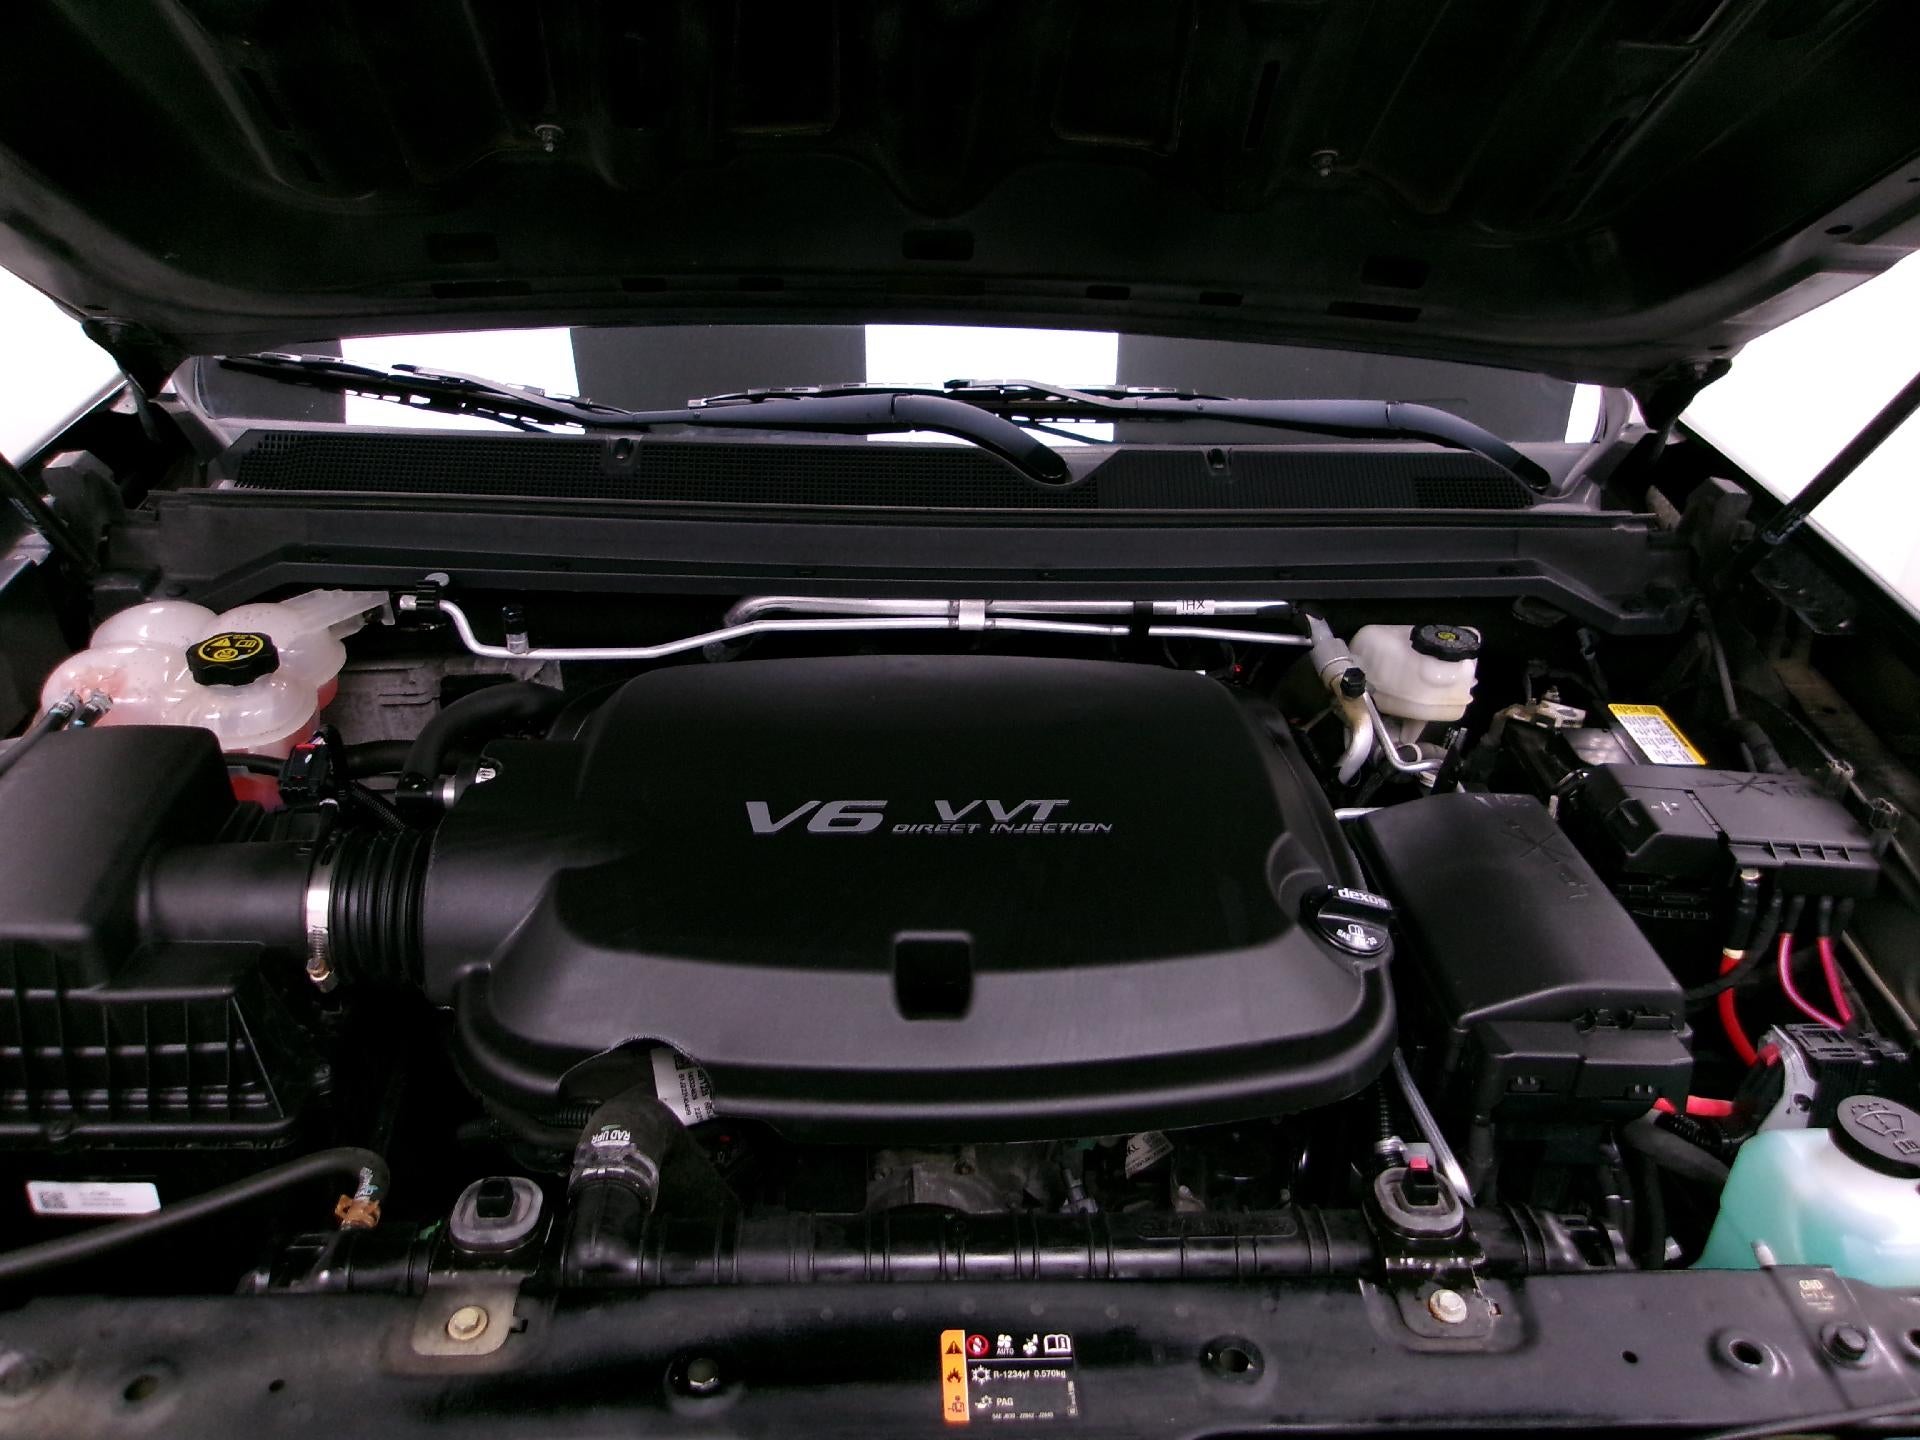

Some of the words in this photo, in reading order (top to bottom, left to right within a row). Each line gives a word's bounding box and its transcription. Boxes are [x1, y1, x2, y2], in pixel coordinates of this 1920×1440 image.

[745, 800, 889, 834] V6
[934, 799, 1070, 823] VVT
[892, 823, 981, 834] DIRECT
[989, 823, 1113, 834] INJECTION
[1337, 888, 1387, 907] dexos
[591, 1130, 610, 1144] UPR
[610, 1129, 631, 1141] RAD
[996, 1347, 1015, 1356] AUTO
[993, 1369, 1030, 1380] R-1234yf
[1033, 1369, 1066, 1379] 0.570kg
[996, 1397, 1014, 1406] PAG
